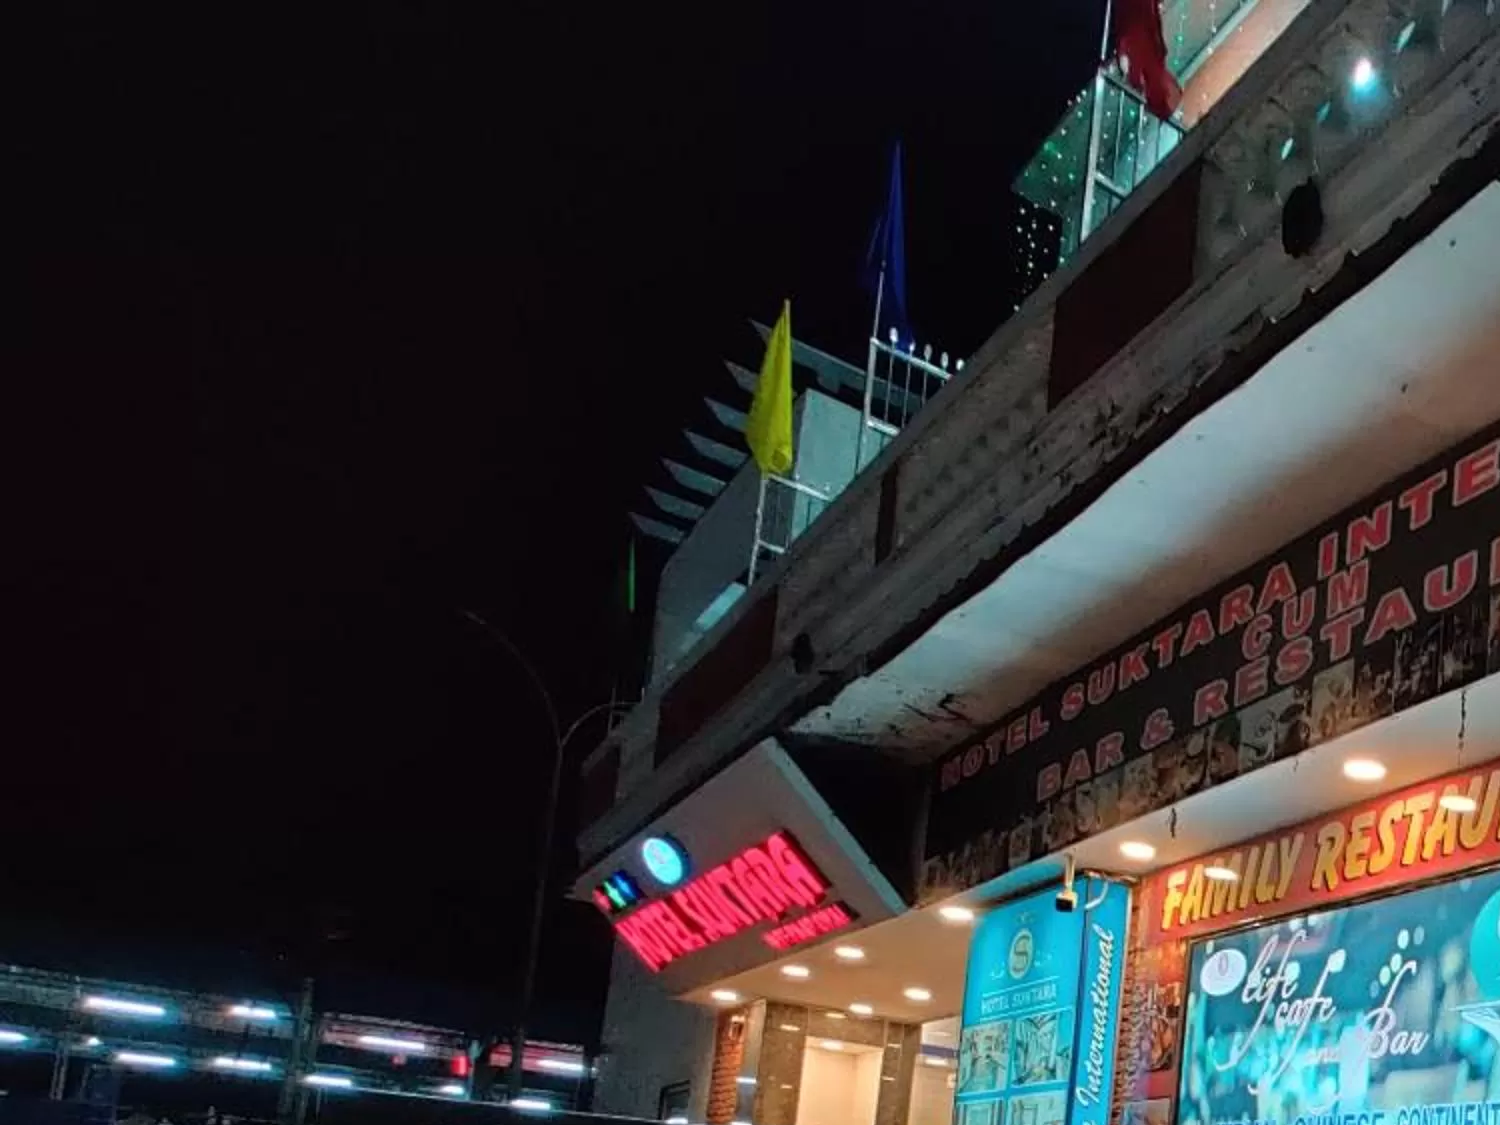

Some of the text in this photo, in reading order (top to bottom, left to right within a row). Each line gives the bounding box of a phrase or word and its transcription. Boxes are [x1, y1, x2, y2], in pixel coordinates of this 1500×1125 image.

[1242, 558, 1369, 660] CUM
[941, 706, 1049, 792] HOTEL
[1060, 561, 1296, 721] SUKTARA
[1037, 731, 1125, 802] BAR
[1140, 707, 1175, 750] &
[1161, 831, 1305, 932] FAMILY
[1075, 922, 1115, 1111] International
